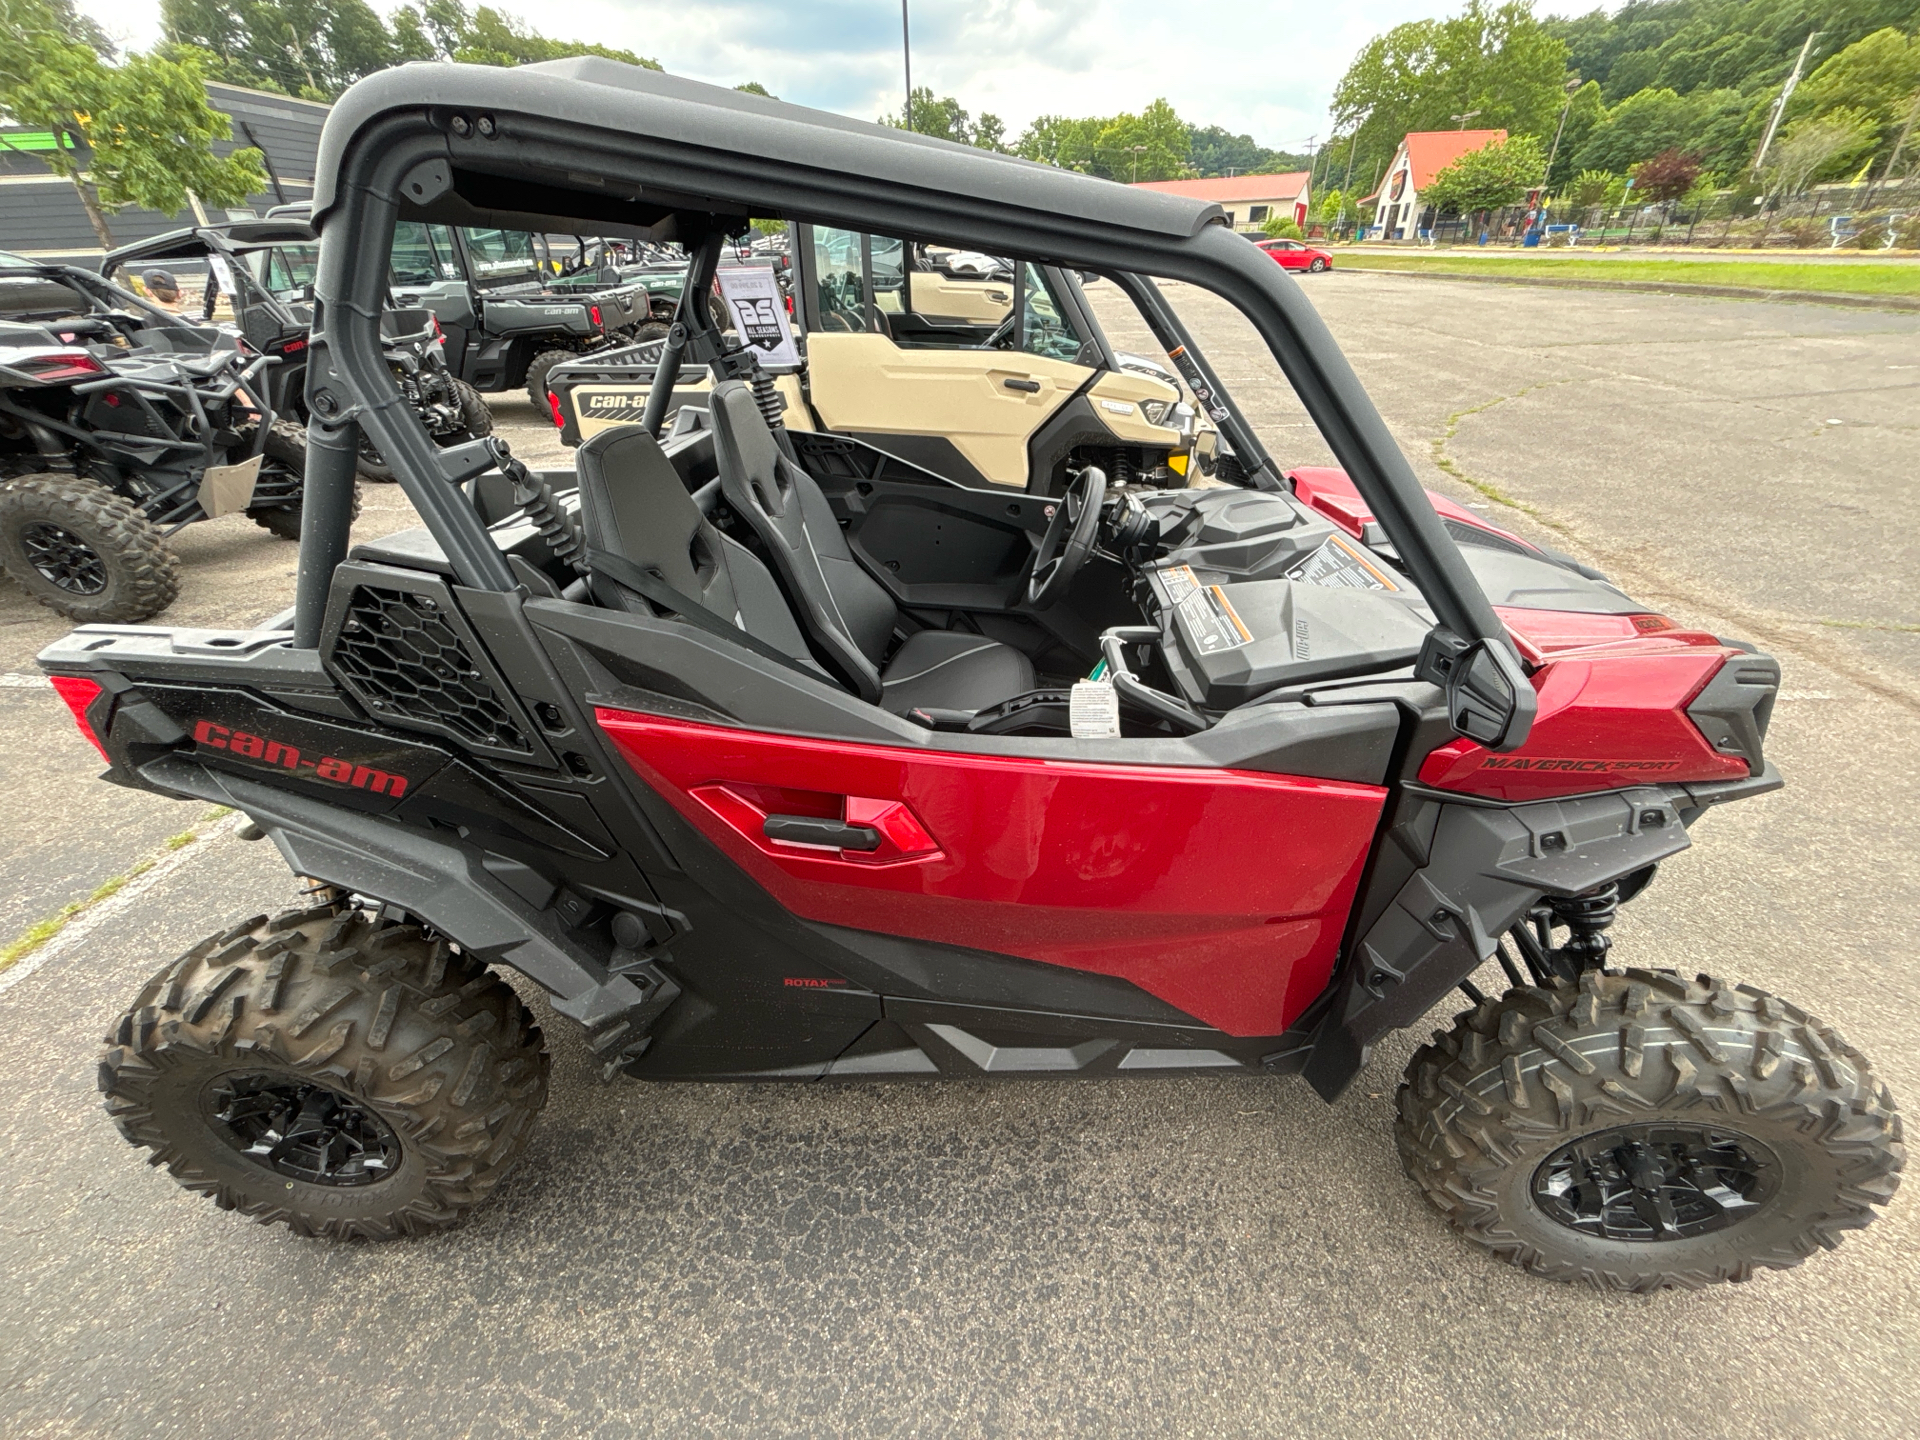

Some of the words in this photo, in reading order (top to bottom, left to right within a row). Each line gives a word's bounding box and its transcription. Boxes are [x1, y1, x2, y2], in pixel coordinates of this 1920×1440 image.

[756, 325, 780, 333] SEASONS
[590, 395, 649, 408] can-a
[193, 719, 409, 798] can-am
[1481, 757, 1612, 772] MAVERICK
[1612, 761, 1681, 770] SPORT
[784, 978, 829, 987] ROTAX
